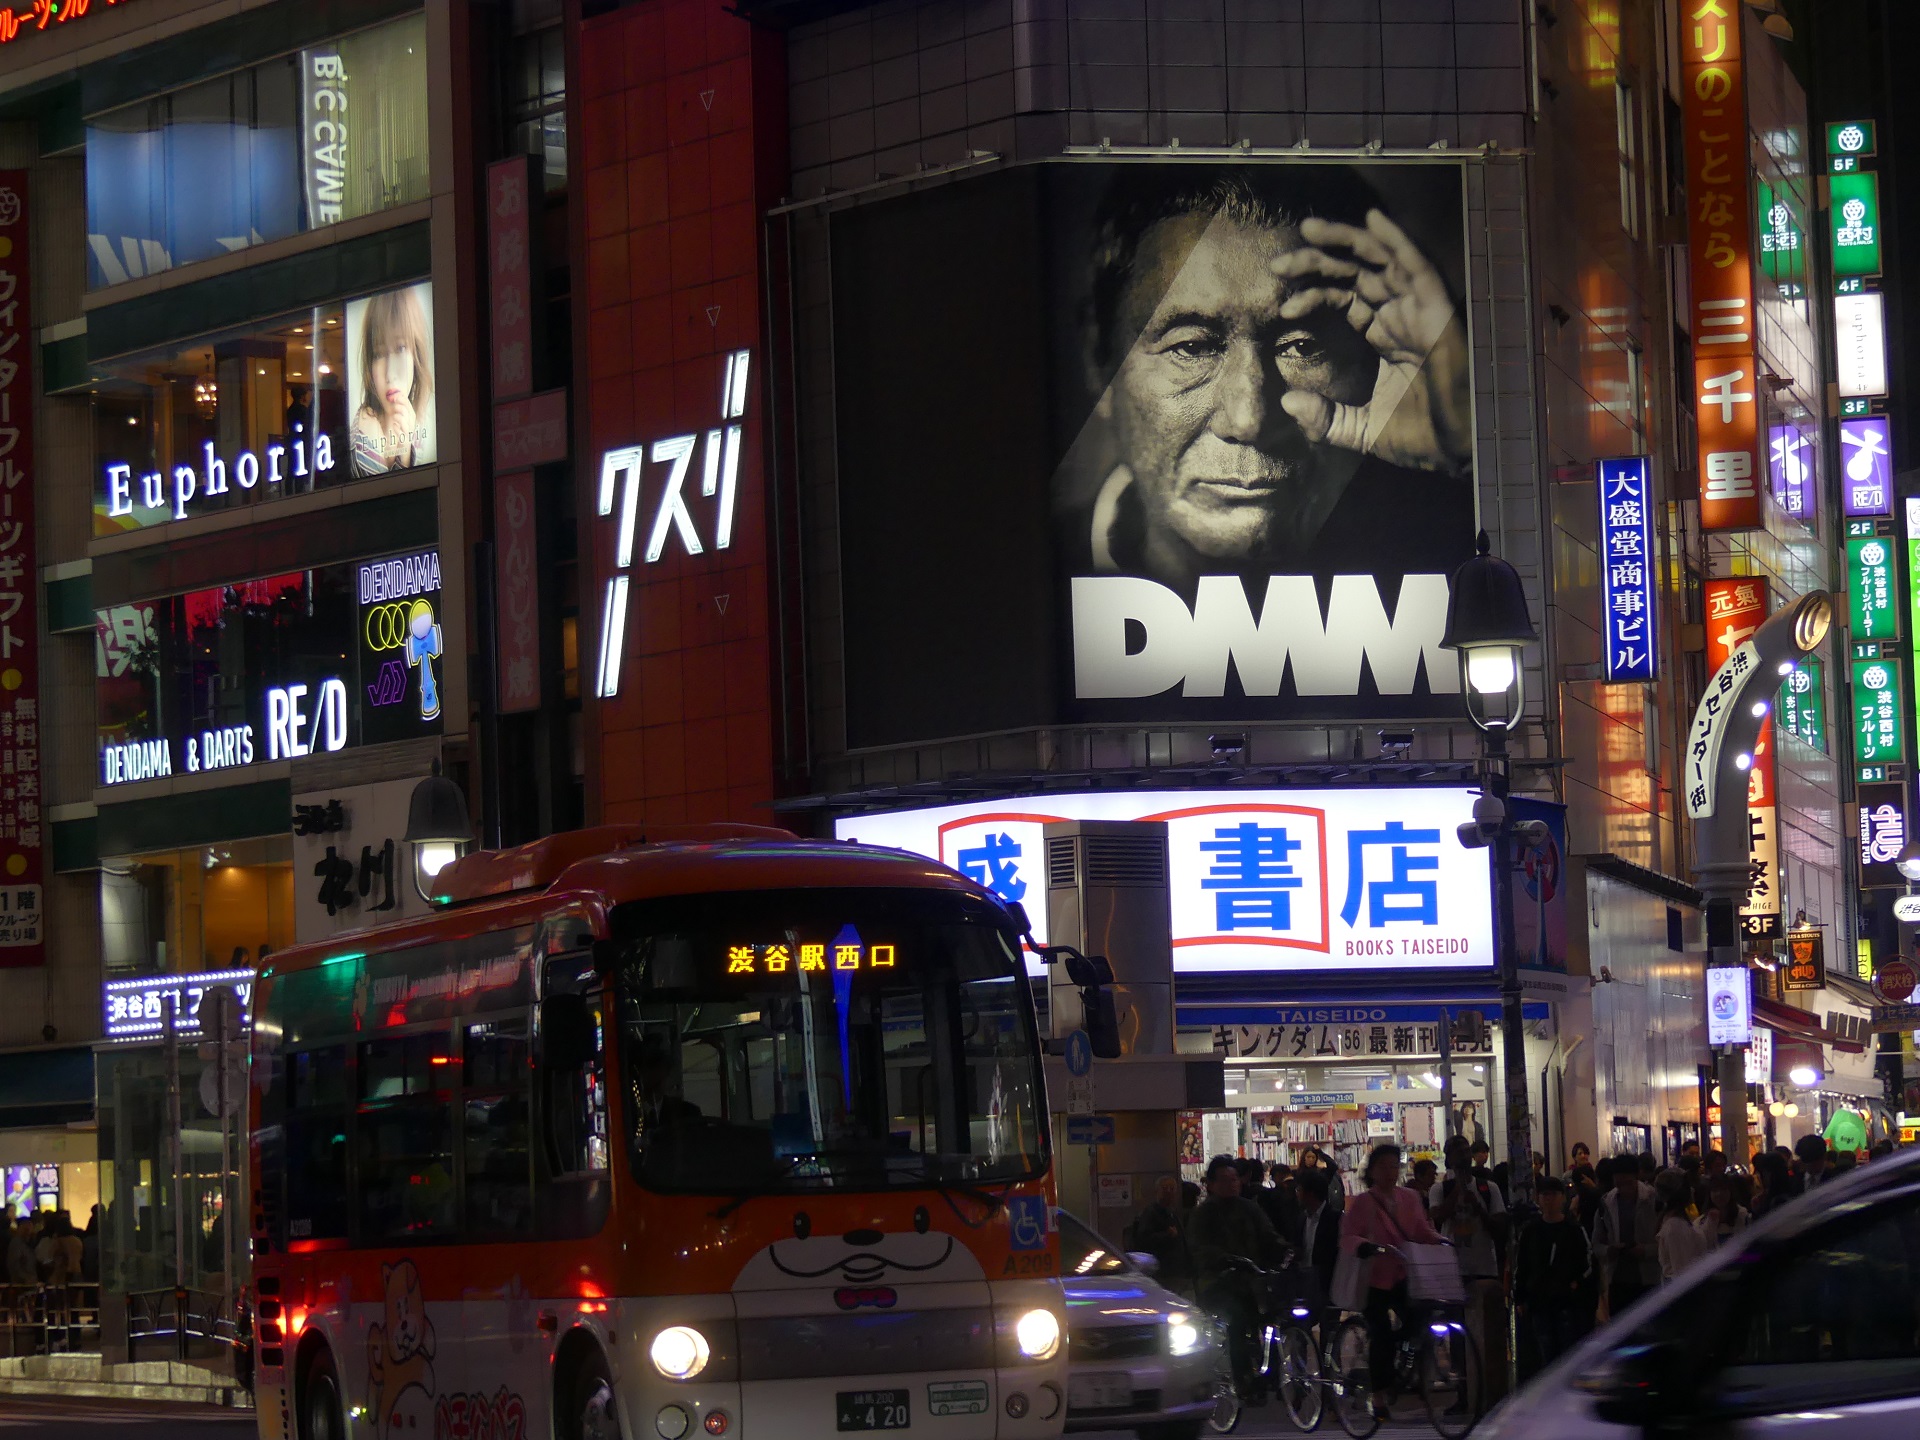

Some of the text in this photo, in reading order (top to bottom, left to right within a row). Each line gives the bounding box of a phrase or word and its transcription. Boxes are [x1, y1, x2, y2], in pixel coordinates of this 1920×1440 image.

[1834, 158, 1854, 171] 5F
[1837, 227, 1873, 243] 西村
[1838, 279, 1859, 292] 4F
[1698, 298, 1757, 501] 三千里
[1843, 401, 1866, 413] 3F
[362, 424, 427, 452] Euphoria
[107, 423, 336, 520] Euphoria
[1852, 490, 1882, 507] RE/D
[1850, 523, 1871, 535] 2F
[361, 553, 441, 604] DENDAMA
[1606, 471, 1647, 670] 大盛堂商事ビル
[1874, 566, 1887, 608] 渋谷西村
[1861, 567, 1873, 637] フルーツパーラー
[1072, 574, 1461, 699] DMM
[1856, 646, 1877, 657] 1F
[268, 679, 348, 760] RE/D
[1689, 651, 1749, 813] 渋谷センター街
[1861, 706, 1876, 759] フルーツ
[1878, 691, 1894, 747] 渋谷西村
[106, 725, 254, 785] DENDAMA & DARTS
[14, 697, 41, 849] 無料配送地域
[1862, 768, 1882, 779] B1
[1860, 807, 1871, 866] BRITISH PUB
[1870, 804, 1903, 863] HUB
[729, 945, 894, 973] 渋谷駅西口
[1345, 937, 1470, 957] BOOKS TAISEIDO
[1791, 965, 1816, 979] HUB
[1276, 1009, 1387, 1023] TAISEIDO
[1290, 1095, 1321, 1104] Open 9:30
[1003, 1253, 1053, 1276] A209
